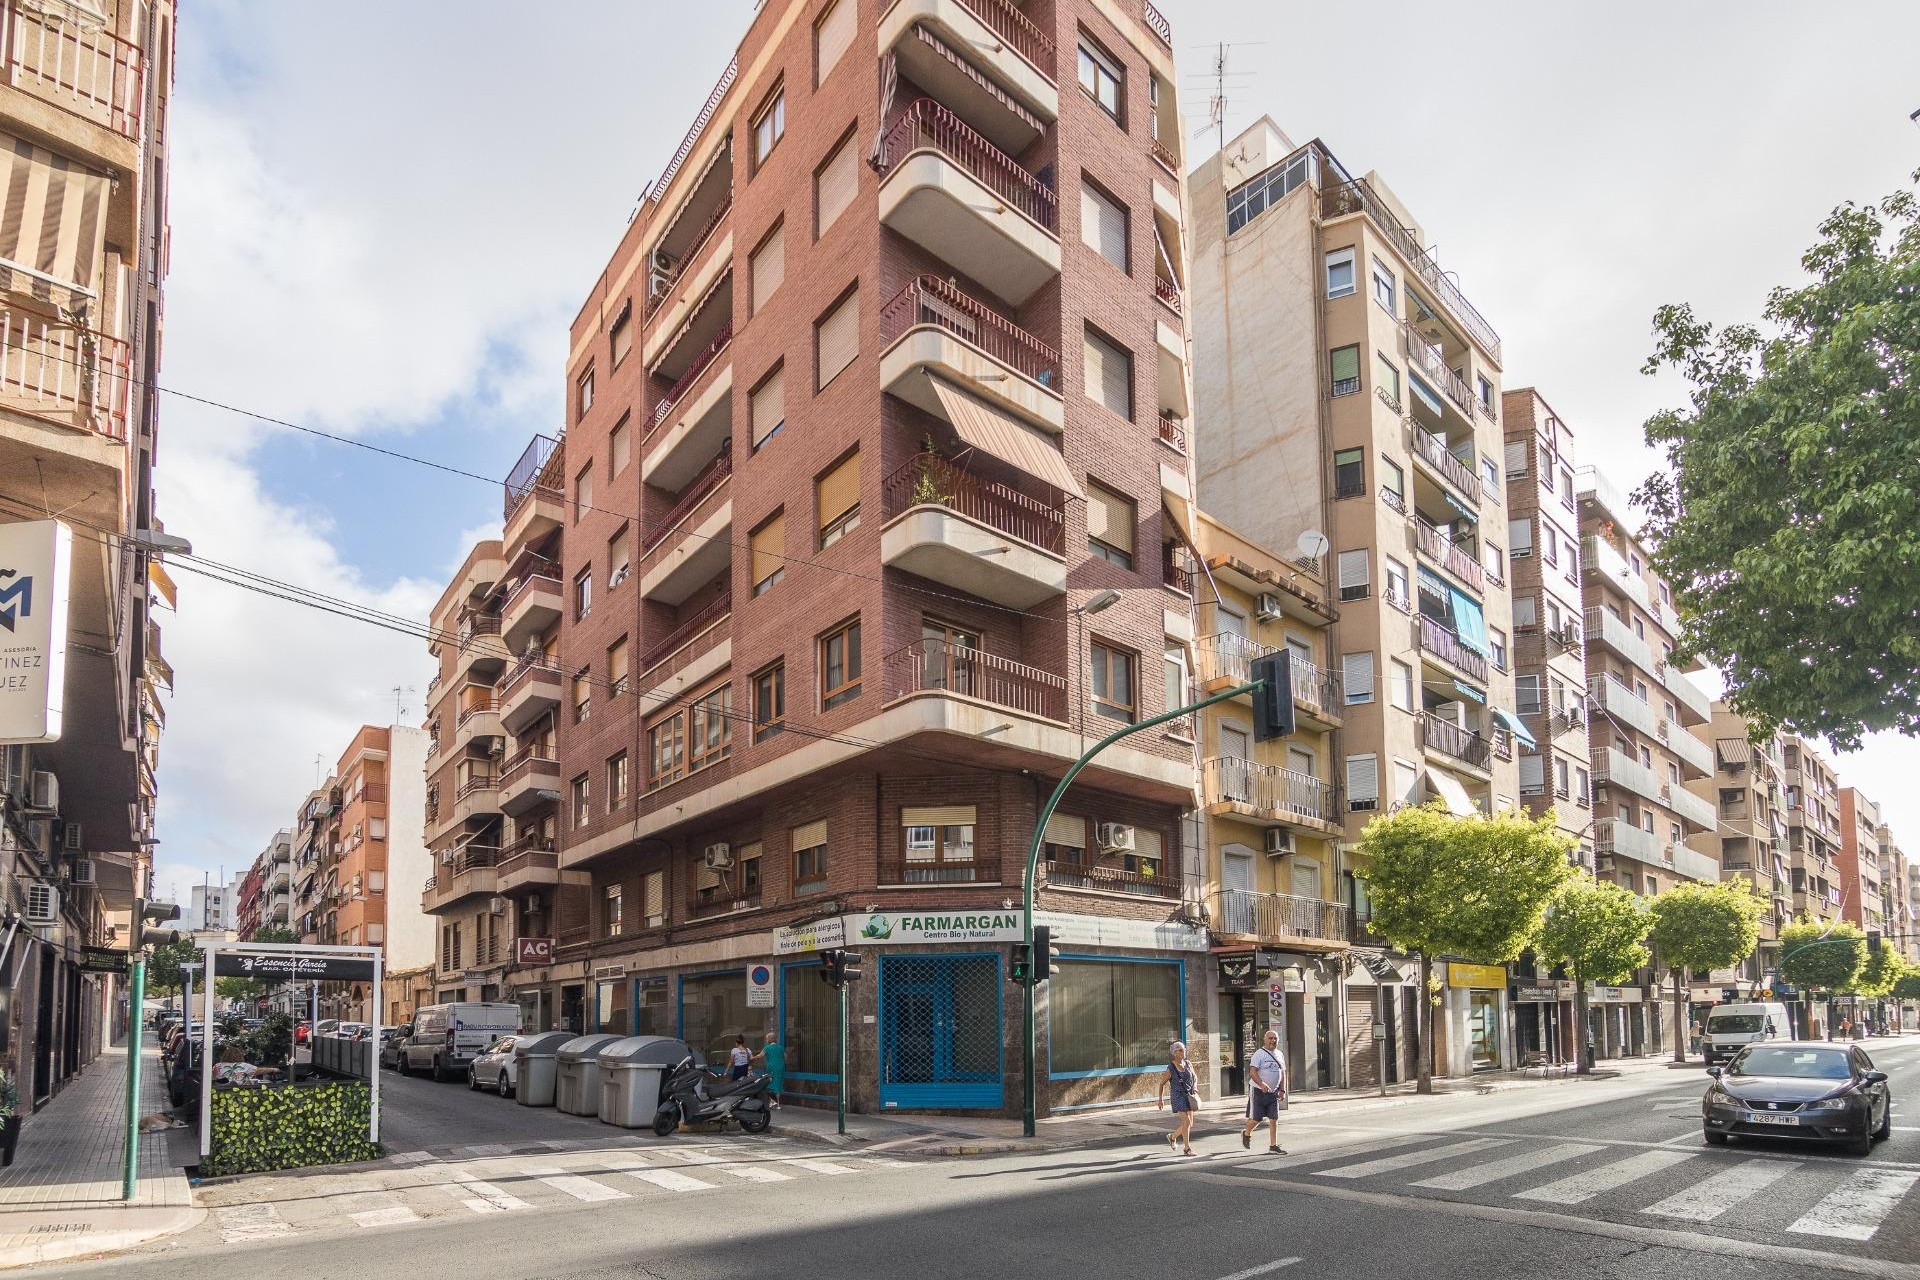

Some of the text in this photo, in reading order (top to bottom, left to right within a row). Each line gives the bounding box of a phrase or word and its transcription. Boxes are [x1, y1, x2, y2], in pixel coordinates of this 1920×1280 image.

[901, 915, 1017, 930] FARMARGAN
[806, 926, 817, 935] para
[523, 942, 549, 955] AG
[1753, 1115, 1796, 1124] 4287 HWP
